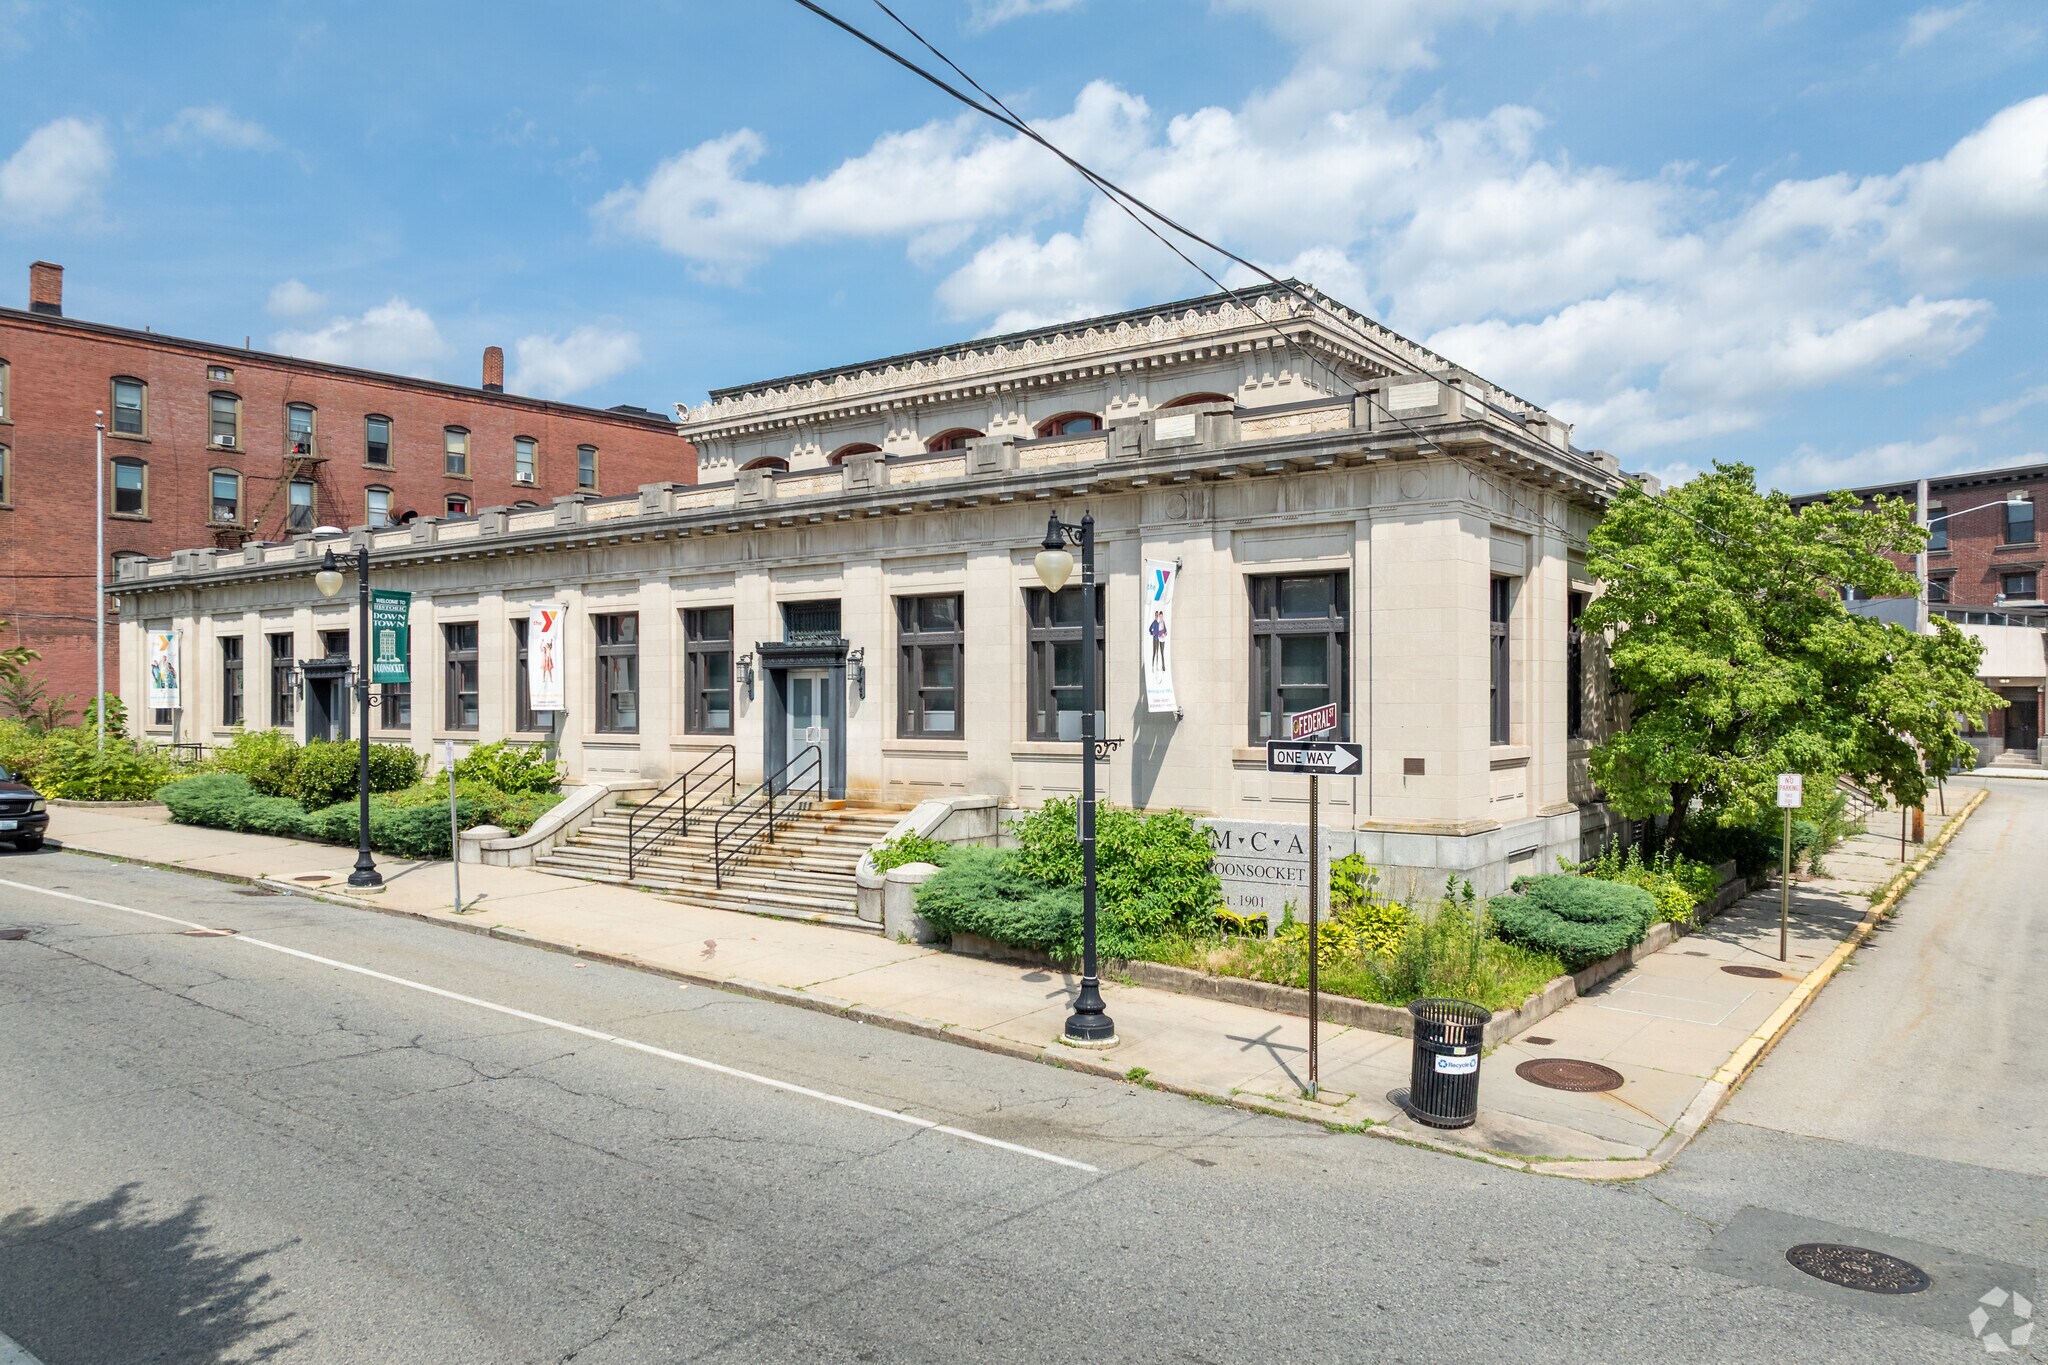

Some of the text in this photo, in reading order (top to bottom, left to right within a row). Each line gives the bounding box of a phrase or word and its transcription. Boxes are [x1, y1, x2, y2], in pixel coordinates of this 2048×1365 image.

[374, 604, 406, 612] HISTORIC
[374, 612, 406, 620] DOWN
[373, 663, 405, 673] WOONSOCKET
[1298, 707, 1334, 736] FEDERAL ST
[1277, 750, 1333, 765] ONE WAY
[1211, 862, 1306, 882] OONSOCKET
[1240, 895, 1265, 908] 1901
